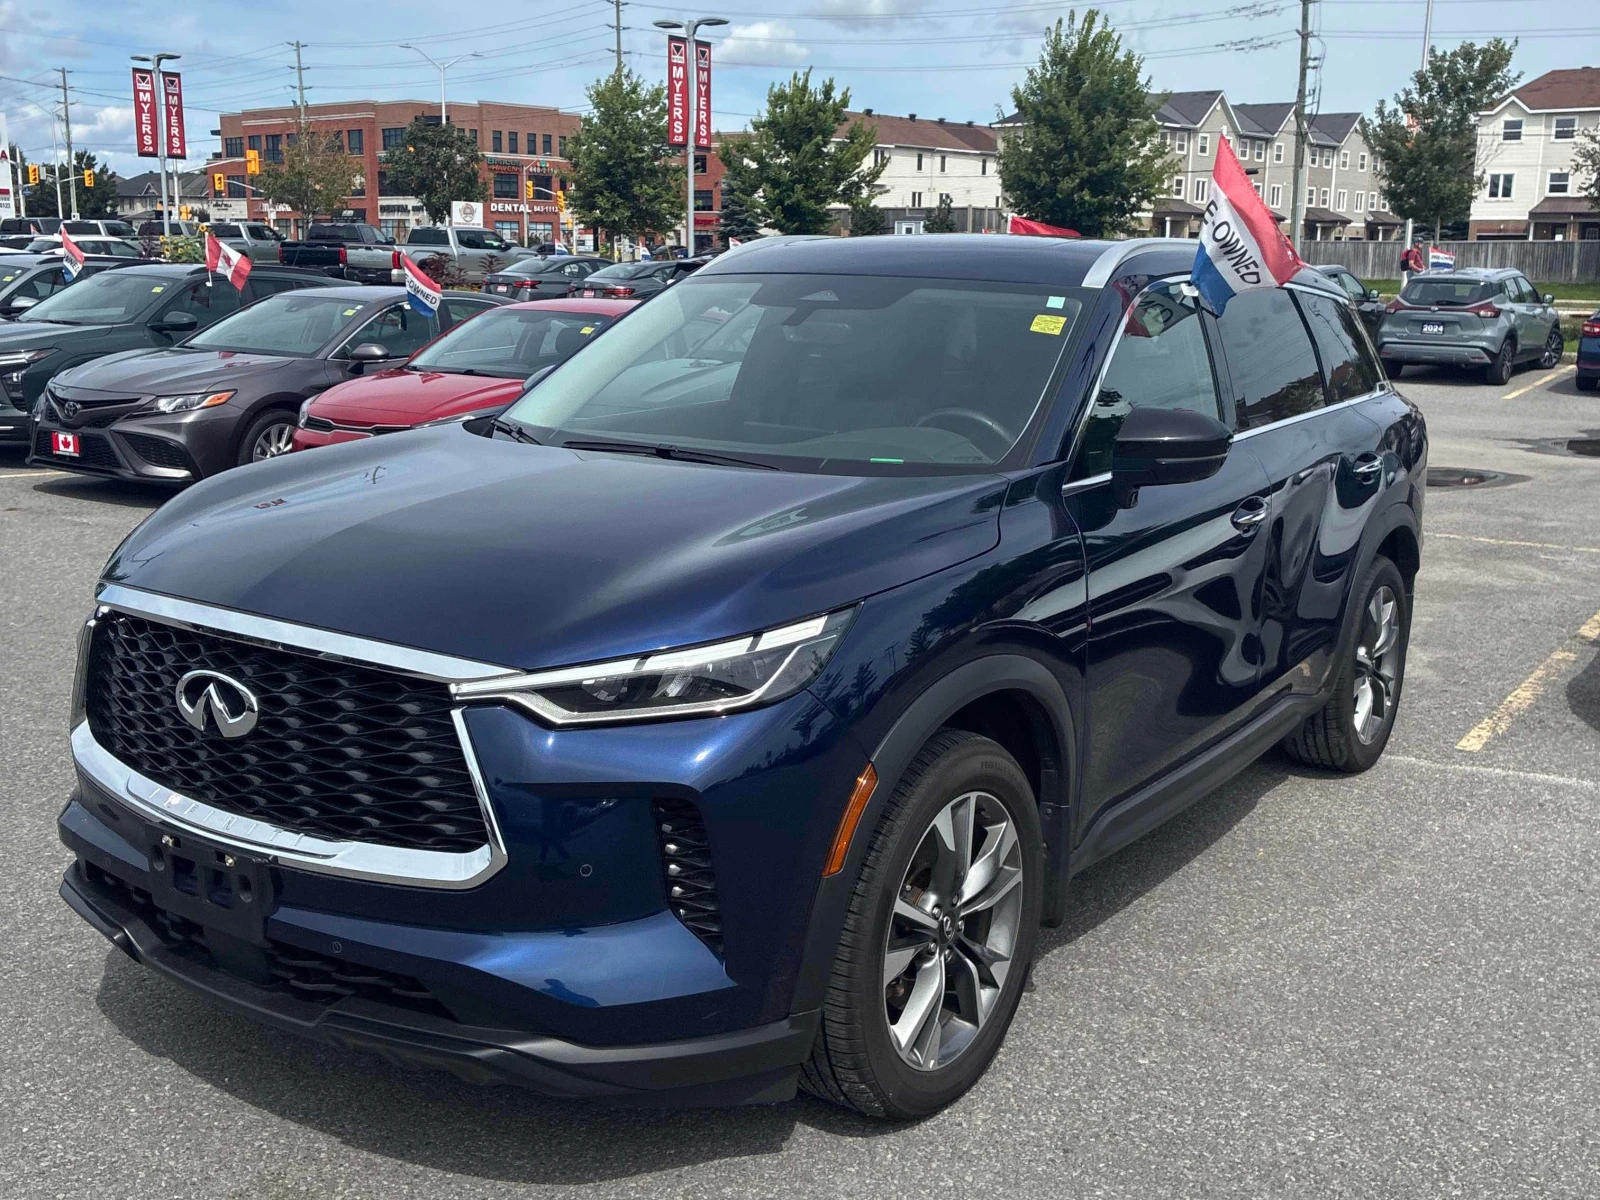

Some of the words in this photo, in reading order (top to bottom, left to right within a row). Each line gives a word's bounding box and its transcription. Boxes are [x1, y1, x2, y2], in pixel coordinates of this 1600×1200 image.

[138, 91, 153, 146] MYERS
[168, 95, 180, 147] MYERS
[672, 65, 684, 133] MYERS
[699, 70, 707, 136] MYERS
[490, 202, 532, 213] DENTAL
[1422, 324, 1444, 332] 2024
